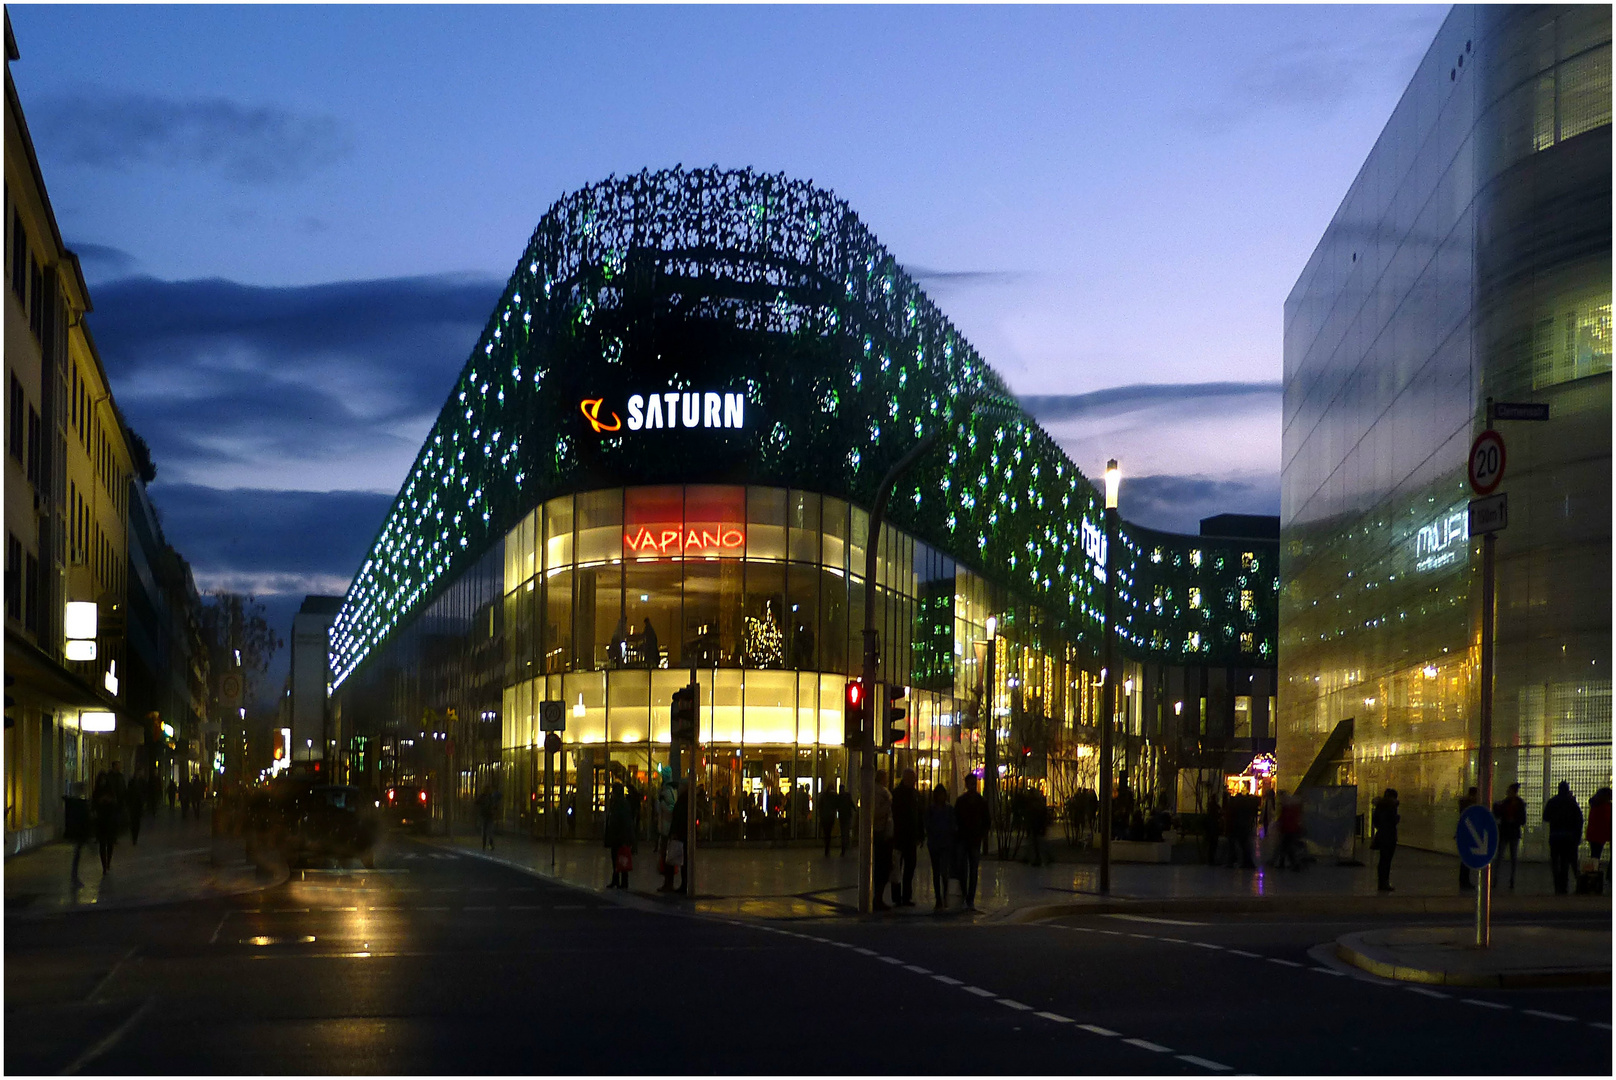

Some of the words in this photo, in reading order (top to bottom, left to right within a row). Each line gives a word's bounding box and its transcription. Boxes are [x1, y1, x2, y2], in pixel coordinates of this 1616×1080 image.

[627, 392, 744, 431] SATURN
[1477, 445, 1498, 478] 20
[625, 524, 743, 554] VAPIANO
